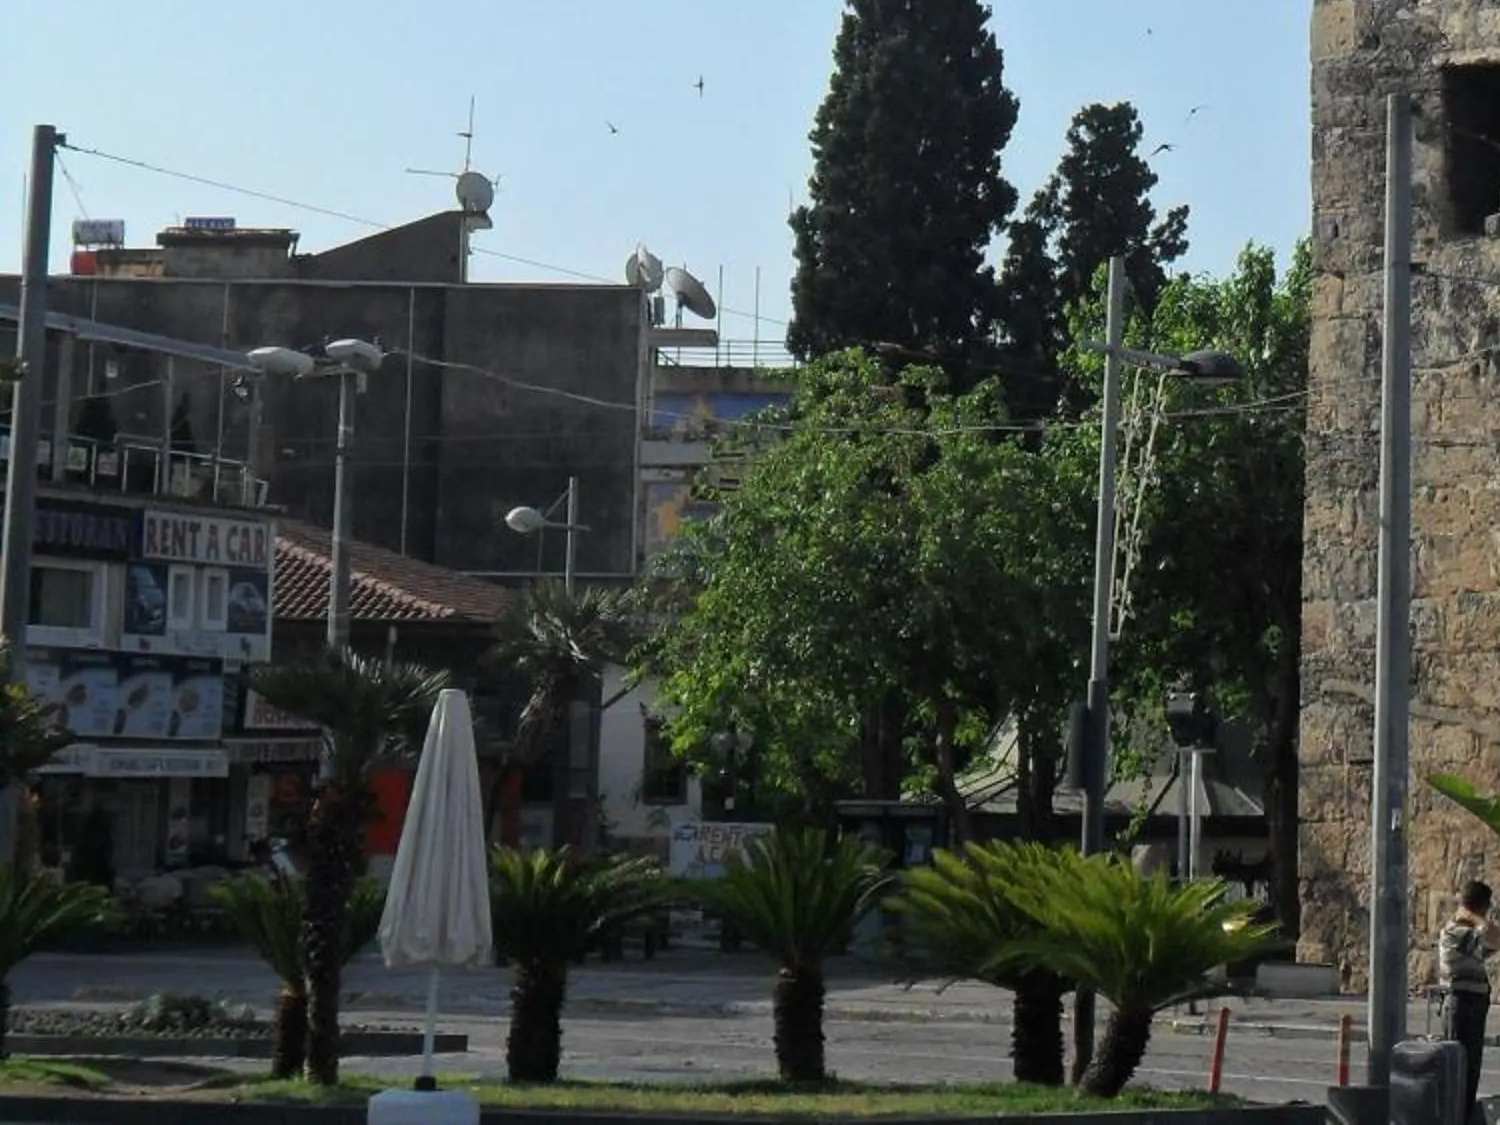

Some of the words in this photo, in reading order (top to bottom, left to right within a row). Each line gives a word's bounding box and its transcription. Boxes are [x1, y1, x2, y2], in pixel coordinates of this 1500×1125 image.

[146, 518, 199, 558] RENT
[207, 524, 220, 560] A
[227, 527, 267, 567] CAR
